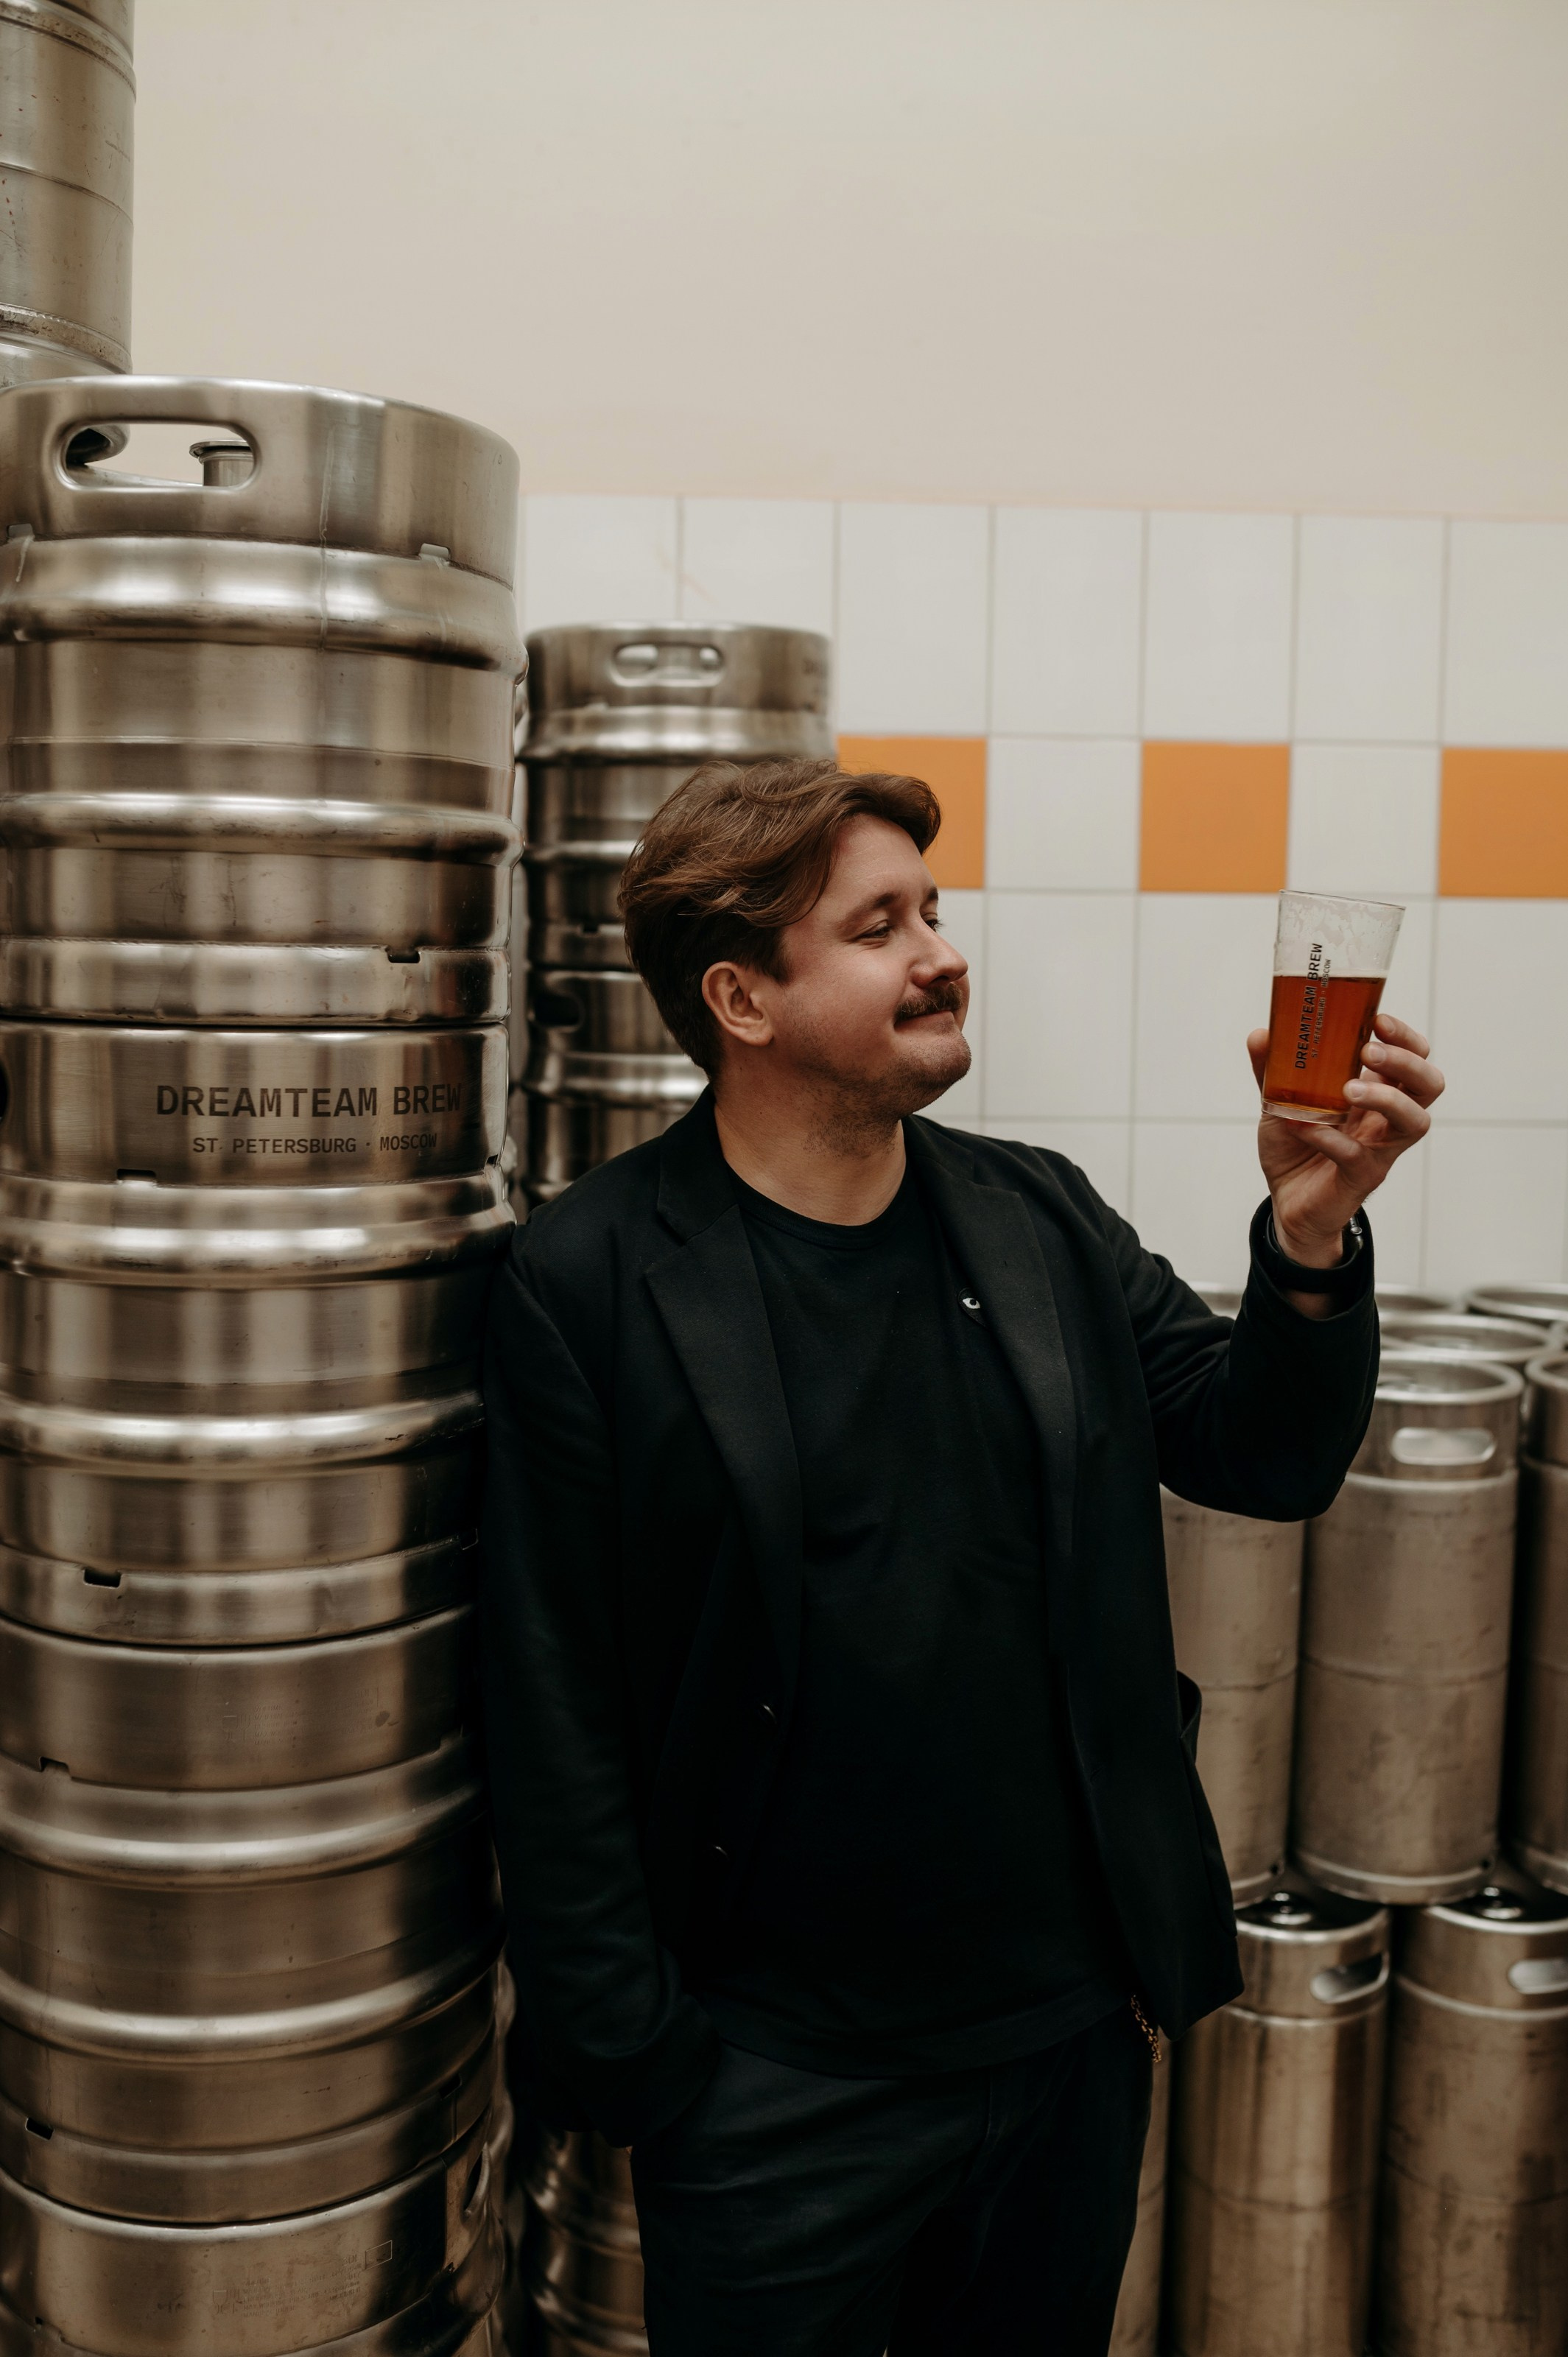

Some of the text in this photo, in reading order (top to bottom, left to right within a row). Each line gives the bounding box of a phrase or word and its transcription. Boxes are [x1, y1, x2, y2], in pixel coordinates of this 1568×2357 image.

[1295, 943, 1323, 1069] DREAMTEAM BREW
[1314, 997, 1326, 1044] PETERSBURG
[1321, 959, 1332, 988] MOSCOW
[156, 1083, 462, 1117] DREAMTEAM BREW
[232, 1137, 356, 1153] PETERSBURG
[380, 1132, 437, 1151] MOSCOW
